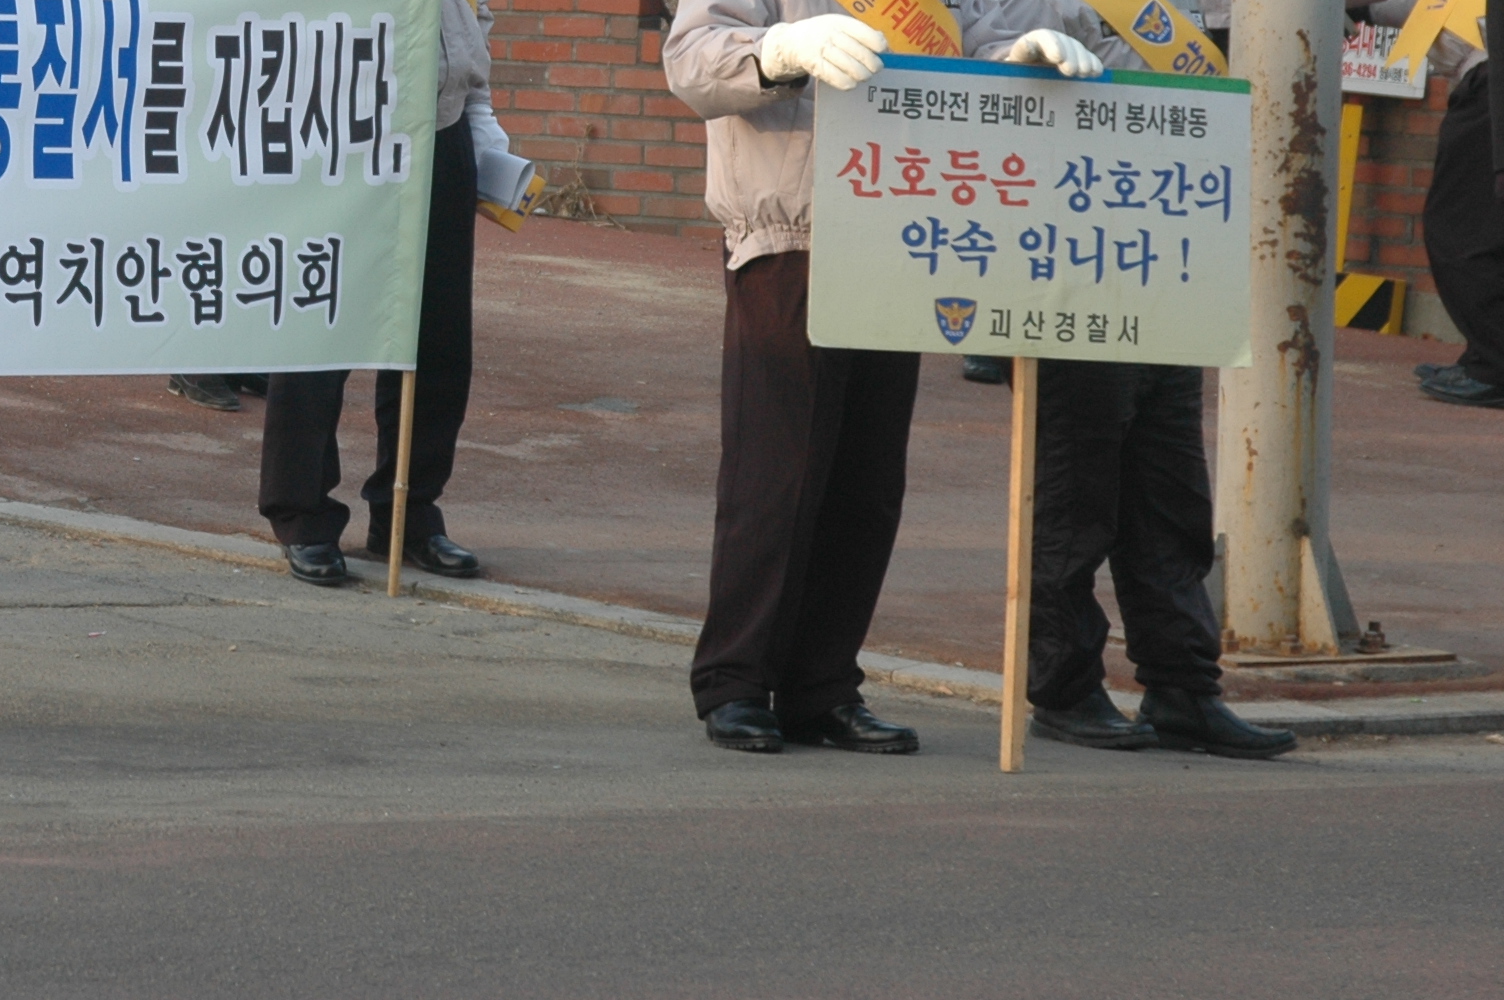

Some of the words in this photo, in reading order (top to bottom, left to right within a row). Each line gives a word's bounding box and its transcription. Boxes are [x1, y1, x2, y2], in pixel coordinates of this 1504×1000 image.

[206, 20, 404, 177] 지킵시다.
[1075, 99, 1118, 132] 참여
[1125, 103, 1209, 139] 봉사활동
[836, 141, 1038, 208] 신호등은
[1055, 155, 1234, 223] 상호간의
[901, 216, 999, 278] 약속
[989, 308, 1141, 346] 괴산경찰서
